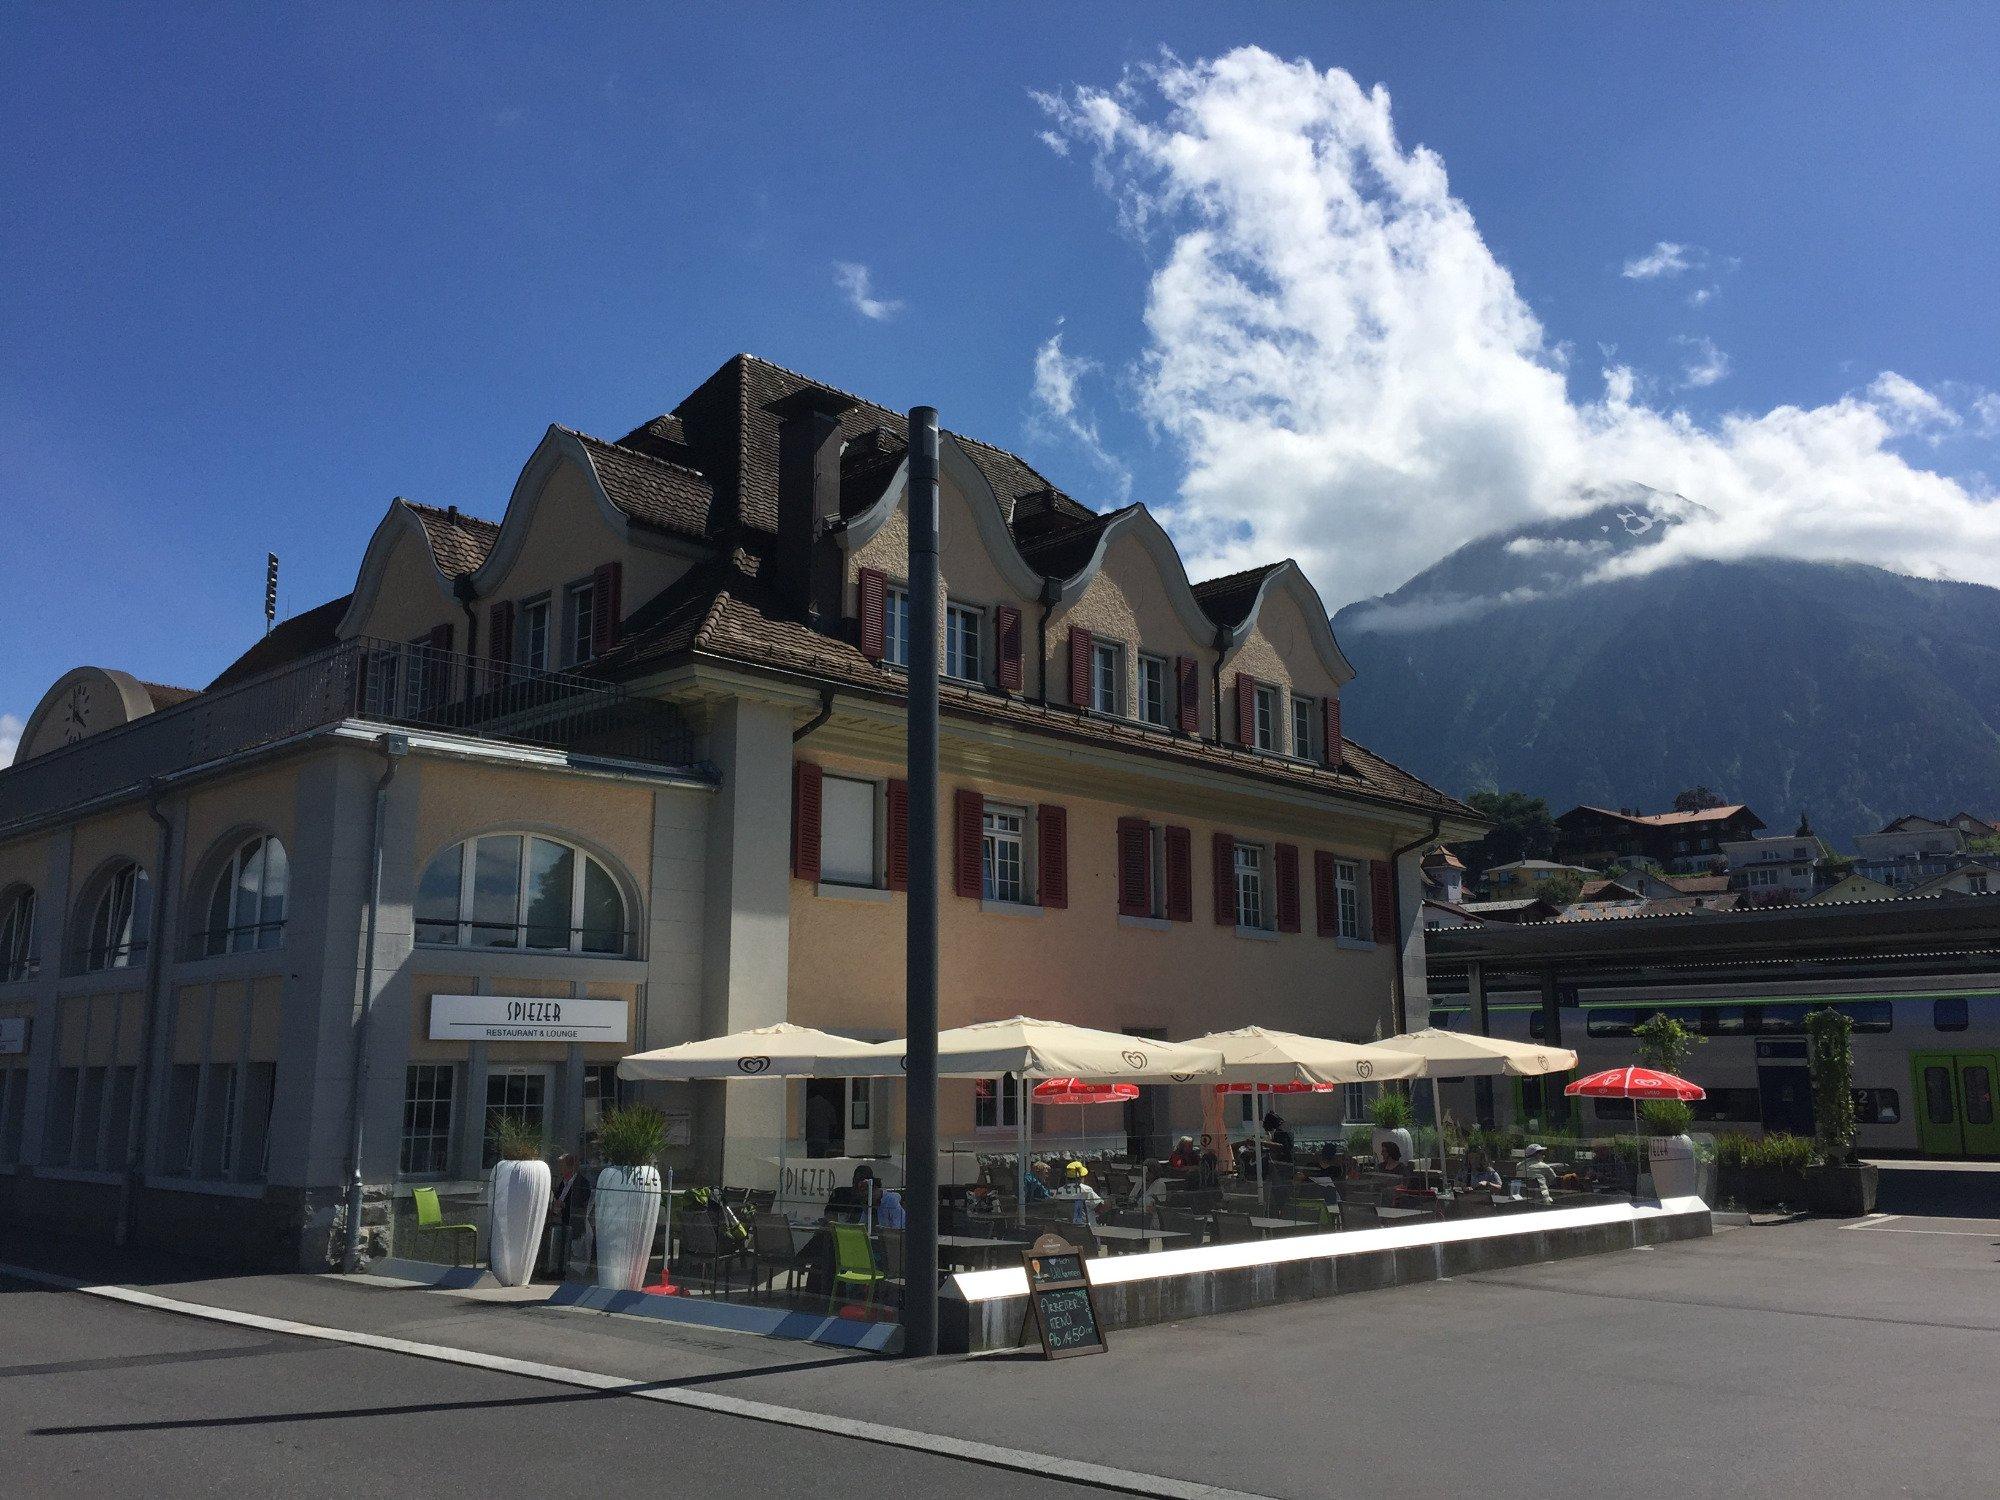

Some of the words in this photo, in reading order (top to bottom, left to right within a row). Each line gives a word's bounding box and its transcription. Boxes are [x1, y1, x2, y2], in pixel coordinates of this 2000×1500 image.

[507, 1001, 562, 1023] SPIEZER
[486, 1028, 538, 1038] RESTAURANT
[539, 1029, 545, 1038] &
[546, 1029, 578, 1039] LOUNGE
[1858, 1089, 1869, 1104] 2
